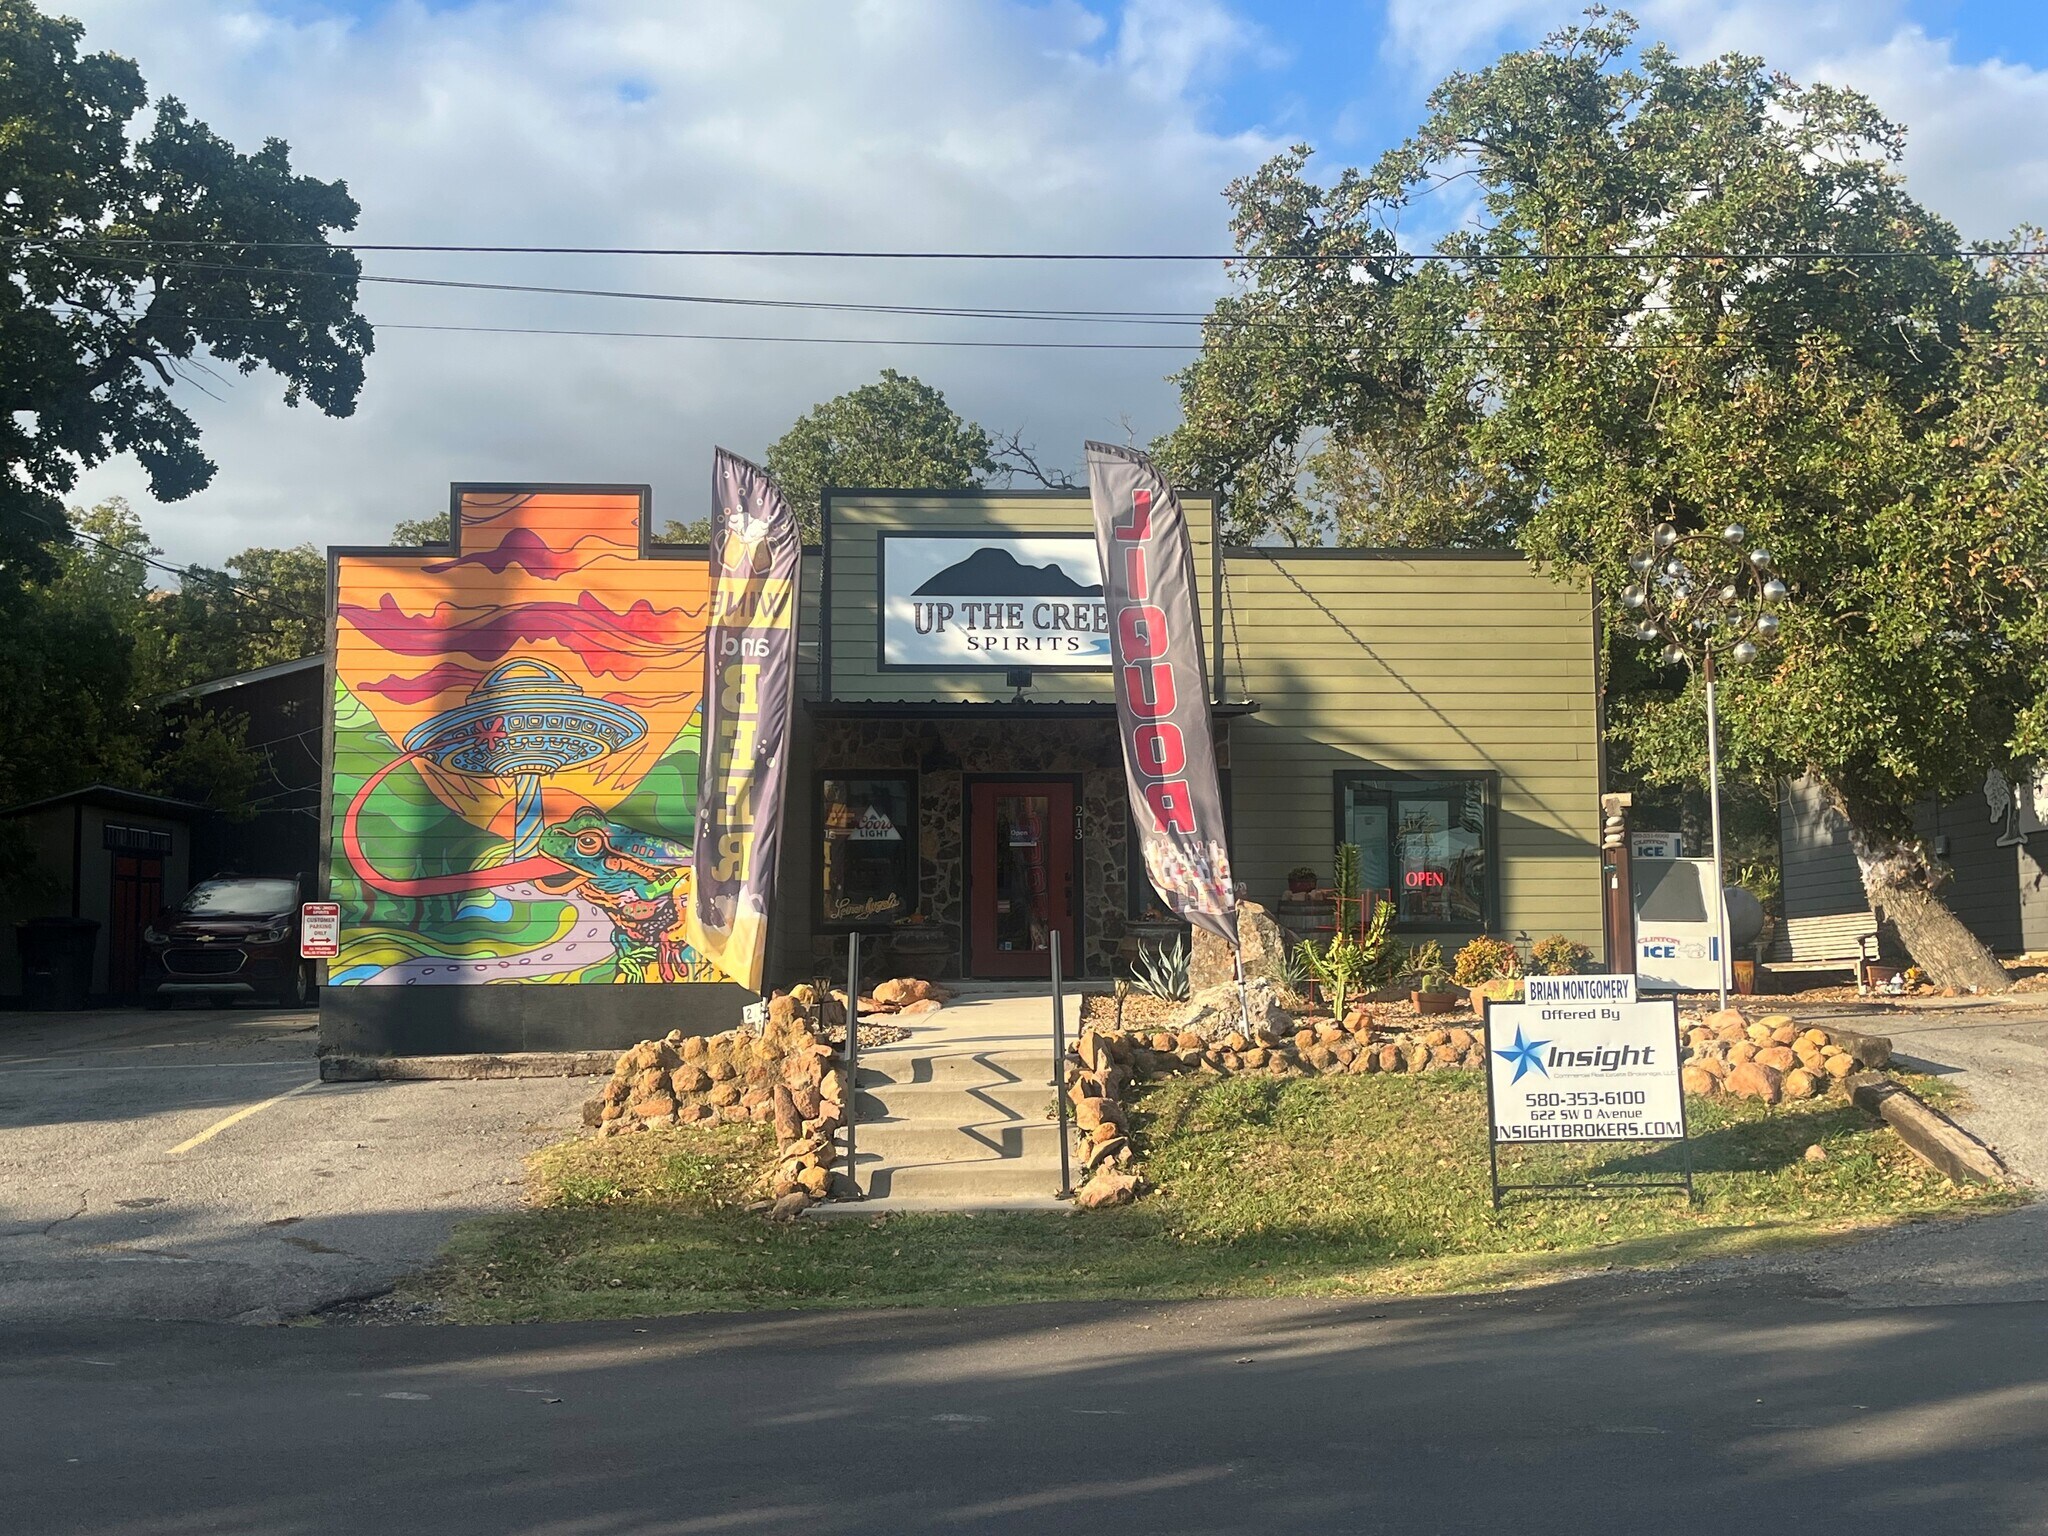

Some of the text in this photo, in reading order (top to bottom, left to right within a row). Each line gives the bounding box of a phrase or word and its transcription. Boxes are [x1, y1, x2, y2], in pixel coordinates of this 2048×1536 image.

[913, 602, 1109, 634] UP THE CREE
[967, 636, 1080, 651] SPIRITS
[857, 815, 893, 830] Coors
[1074, 805, 1083, 840] 213
[859, 829, 889, 838] LIGHT
[1010, 829, 1028, 837] Open
[1638, 846, 1664, 856] ICE
[1405, 871, 1445, 887] OPEN
[1637, 936, 1681, 945] CLINTON
[1643, 946, 1675, 958] ICE
[1530, 979, 1630, 1001] BRIAN MONTGOMERY
[1541, 1008, 1620, 1021] Offered By
[1548, 1045, 1656, 1071] Insight
[1526, 1091, 1645, 1107] 580-353-6100
[1531, 1111, 1555, 1120] 622
[1560, 1110, 1580, 1120] SW
[1596, 1109, 1643, 1119] Avenue
